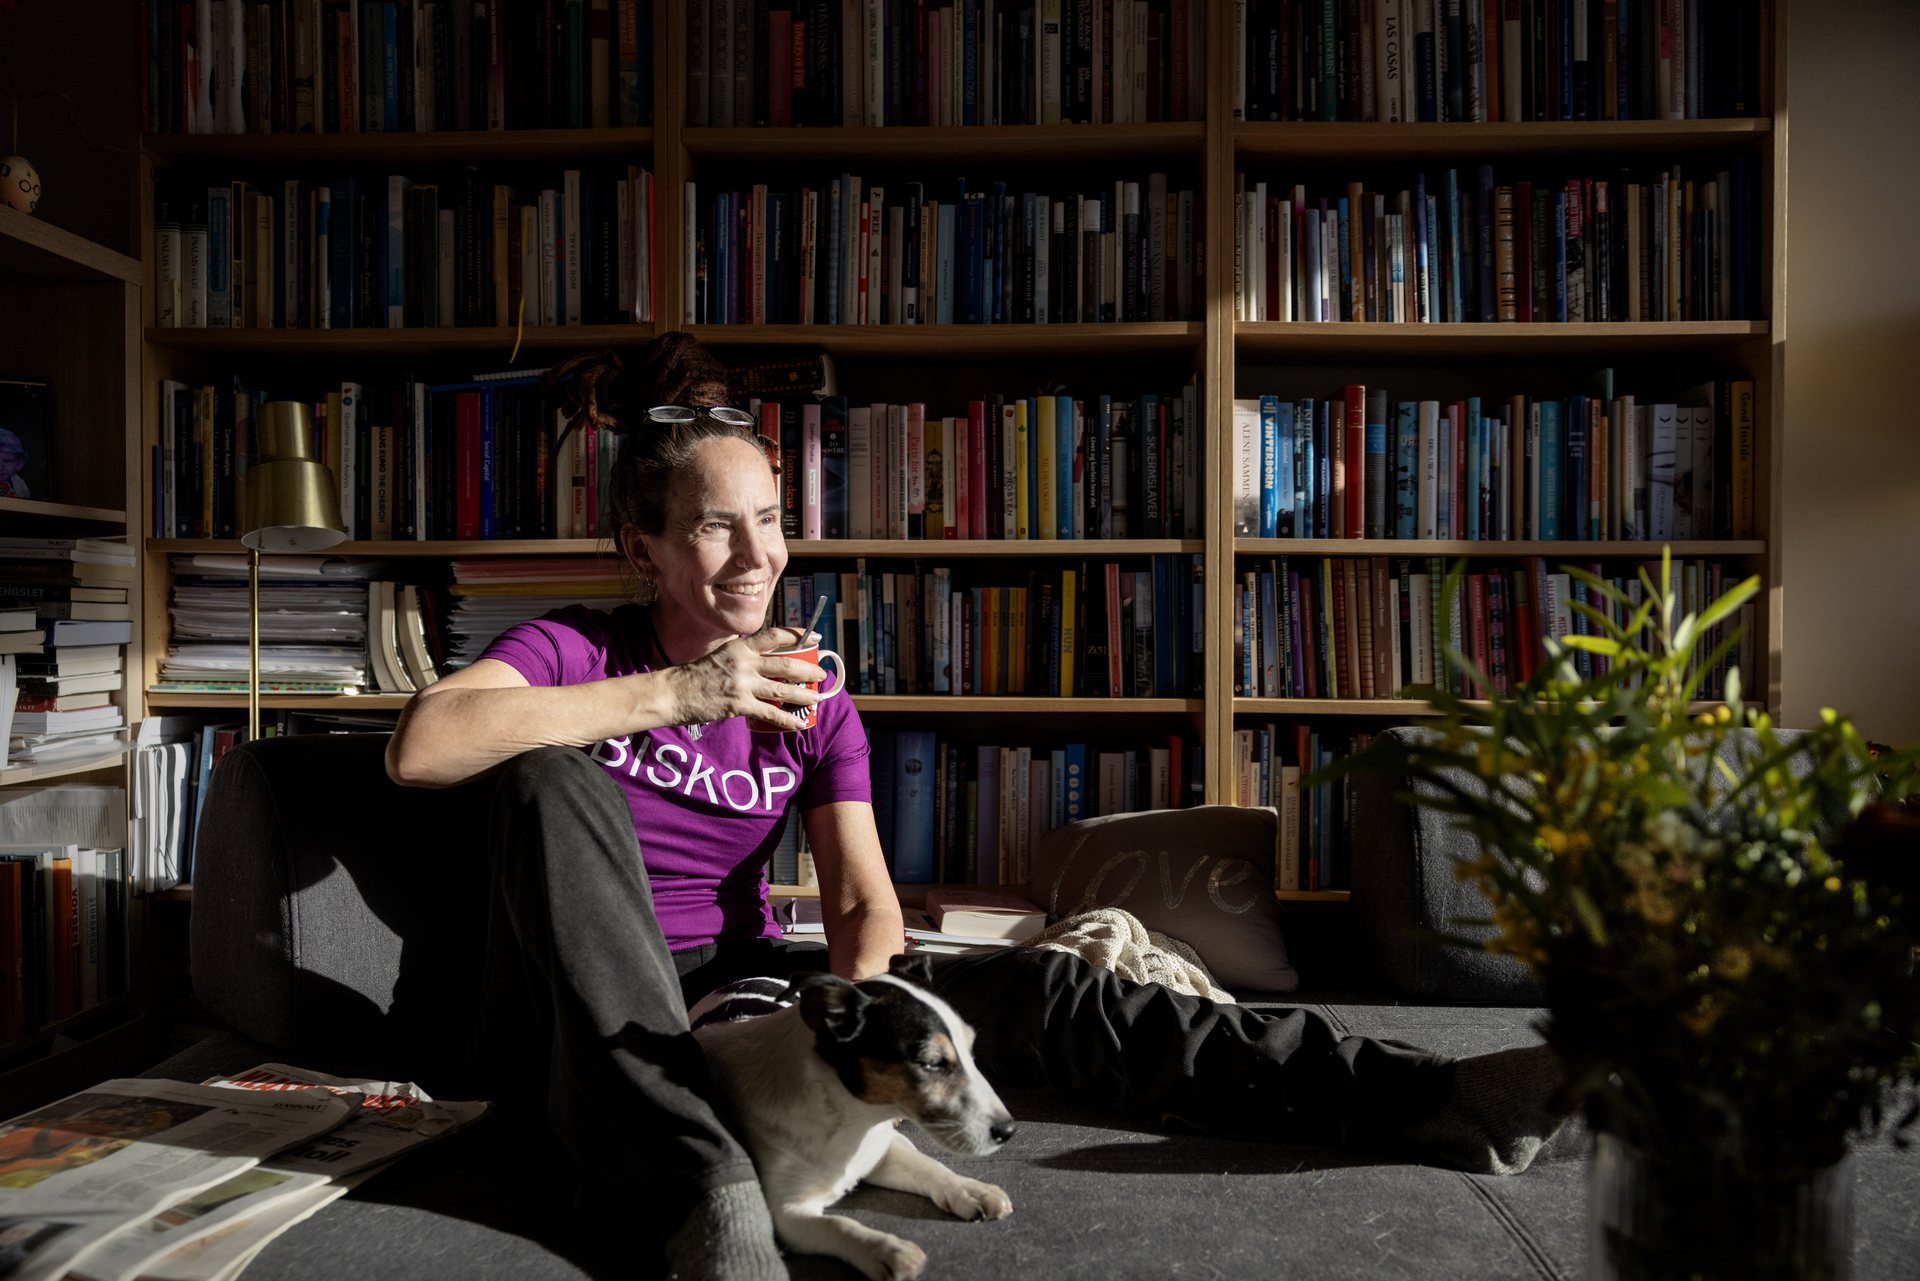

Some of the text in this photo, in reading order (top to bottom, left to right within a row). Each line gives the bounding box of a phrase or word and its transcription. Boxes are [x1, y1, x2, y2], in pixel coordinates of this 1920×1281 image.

[818, 3, 828, 70] CONVERSIONS
[1084, 24, 1090, 35] AN
[1386, 17, 1397, 80] LAS CASAS
[794, 23, 804, 88] TONGUES OF FIRE
[965, 30, 975, 105] RELIGIONSFILOSOFI
[1324, 29, 1333, 75] ECONOMIST
[1350, 31, 1359, 102] Trinity and Society
[872, 210, 880, 235] FREE
[1483, 225, 1492, 242] Tegn
[1571, 216, 1579, 235] TECKEN
[162, 235, 170, 266] PSALMS
[1483, 253, 1492, 266] håp
[1740, 392, 1750, 462] Good Inside
[911, 437, 920, 473] Paris for
[1090, 453, 1096, 461] og
[1102, 454, 1110, 463] ALT
[1242, 422, 1250, 500] ALENE SAMMEN
[785, 449, 796, 509] Homo deus
[1043, 471, 1049, 481] DE
[1147, 436, 1157, 519] SKJERMSLAVER
[1064, 628, 1072, 653] HUN
[590, 733, 797, 812] BISKOP
